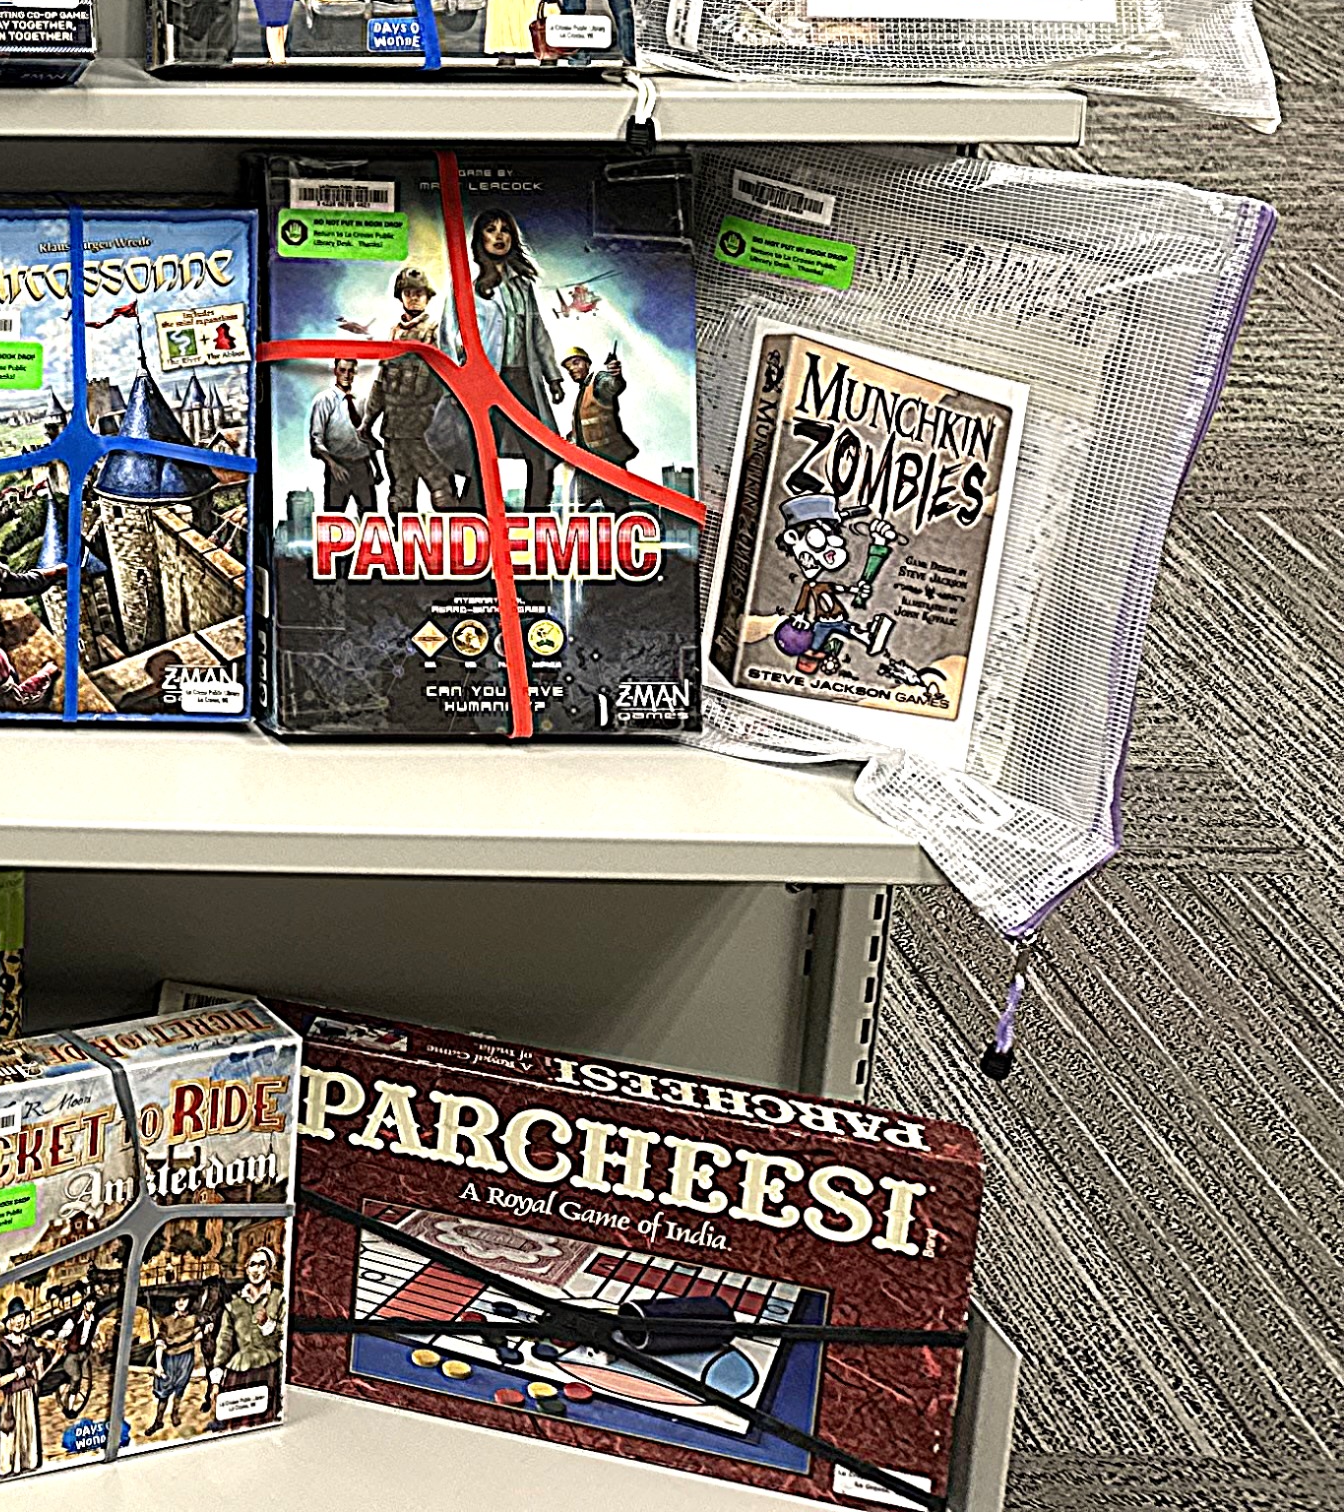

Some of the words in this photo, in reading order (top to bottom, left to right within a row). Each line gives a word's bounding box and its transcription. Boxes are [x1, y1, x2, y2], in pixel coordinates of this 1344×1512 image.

[9, 31, 73, 42] TOGETHER!
[10, 21, 76, 32] TOGETHER,
[794, 353, 997, 462] MUNCHKIN
[785, 421, 987, 535] ZOMBIES
[313, 512, 662, 582] PANDEMIC
[747, 670, 805, 688] STEVE
[809, 678, 893, 702] JACKSON
[895, 689, 950, 710] GAMES
[171, 1076, 289, 1140] RIDE
[298, 1065, 925, 1257] PARCHEESI
[460, 1183, 479, 1201] A
[485, 1186, 554, 1217] Royal
[559, 1200, 630, 1229] Game
[637, 1215, 660, 1234] of
[665, 1221, 732, 1252] India.
